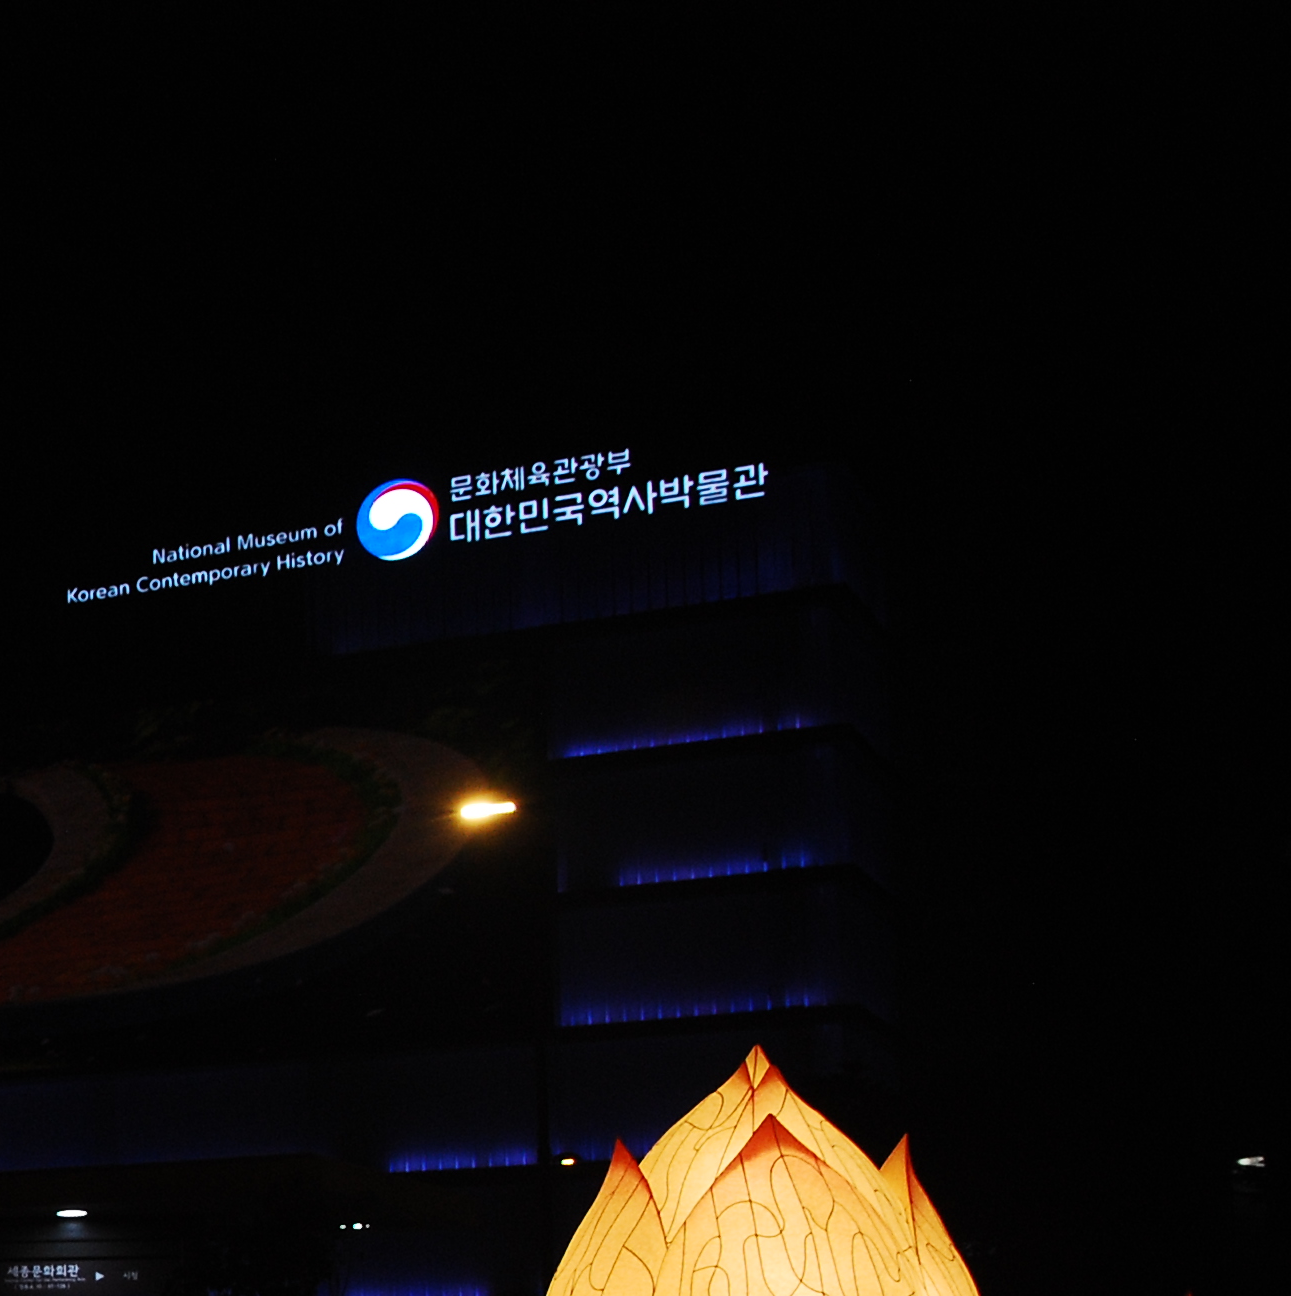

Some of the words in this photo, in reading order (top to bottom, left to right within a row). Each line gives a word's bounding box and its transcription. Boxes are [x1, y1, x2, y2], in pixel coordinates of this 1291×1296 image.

[450, 448, 631, 502] 문화체육관광부
[450, 463, 768, 542] 대한민국역사박물관
[153, 537, 230, 564] National
[238, 527, 317, 550] Museum
[324, 518, 342, 536] of
[67, 583, 130, 603] Korean
[136, 562, 270, 592] Contemporary
[277, 550, 344, 570] History
